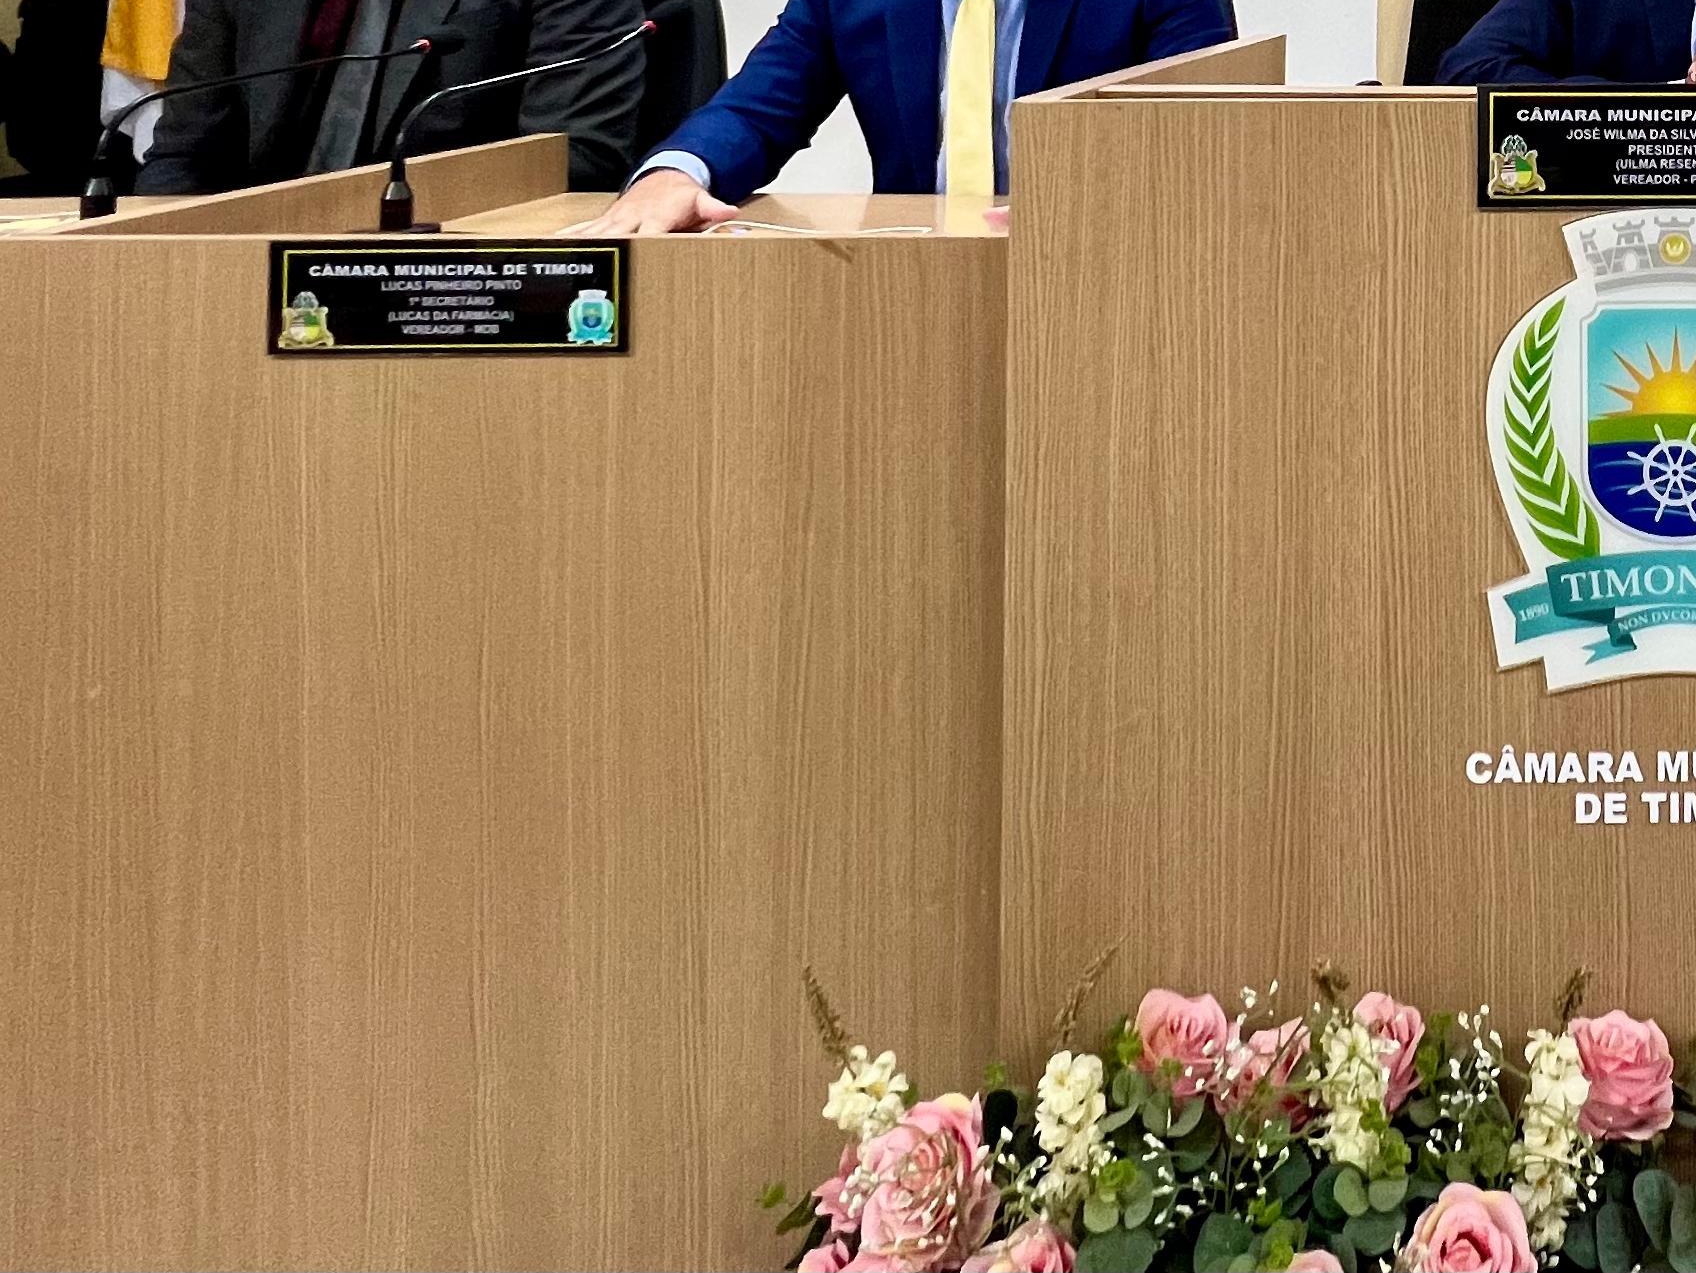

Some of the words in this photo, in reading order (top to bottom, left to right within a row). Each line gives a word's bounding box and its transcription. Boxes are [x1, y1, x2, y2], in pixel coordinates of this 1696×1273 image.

[1516, 107, 1601, 122] CÂMARA
[1566, 127, 1601, 140] JOSÉ
[1603, 128, 1647, 140] WILMA
[1649, 128, 1669, 140] DA
[1615, 158, 1658, 171] (UILMA
[1612, 174, 1681, 185] VEREADOR
[309, 264, 389, 277] CÂMARA
[394, 264, 498, 277] MUNICIPAL
[502, 264, 528, 276] DE
[532, 264, 594, 276] TIMON
[381, 280, 424, 291] LUCAS
[485, 279, 522, 290] PINTO
[433, 311, 450, 320] DA
[1617, 611, 1649, 631] NON
[1466, 744, 1644, 784] CÂMARA
[1575, 792, 1628, 824] DE
